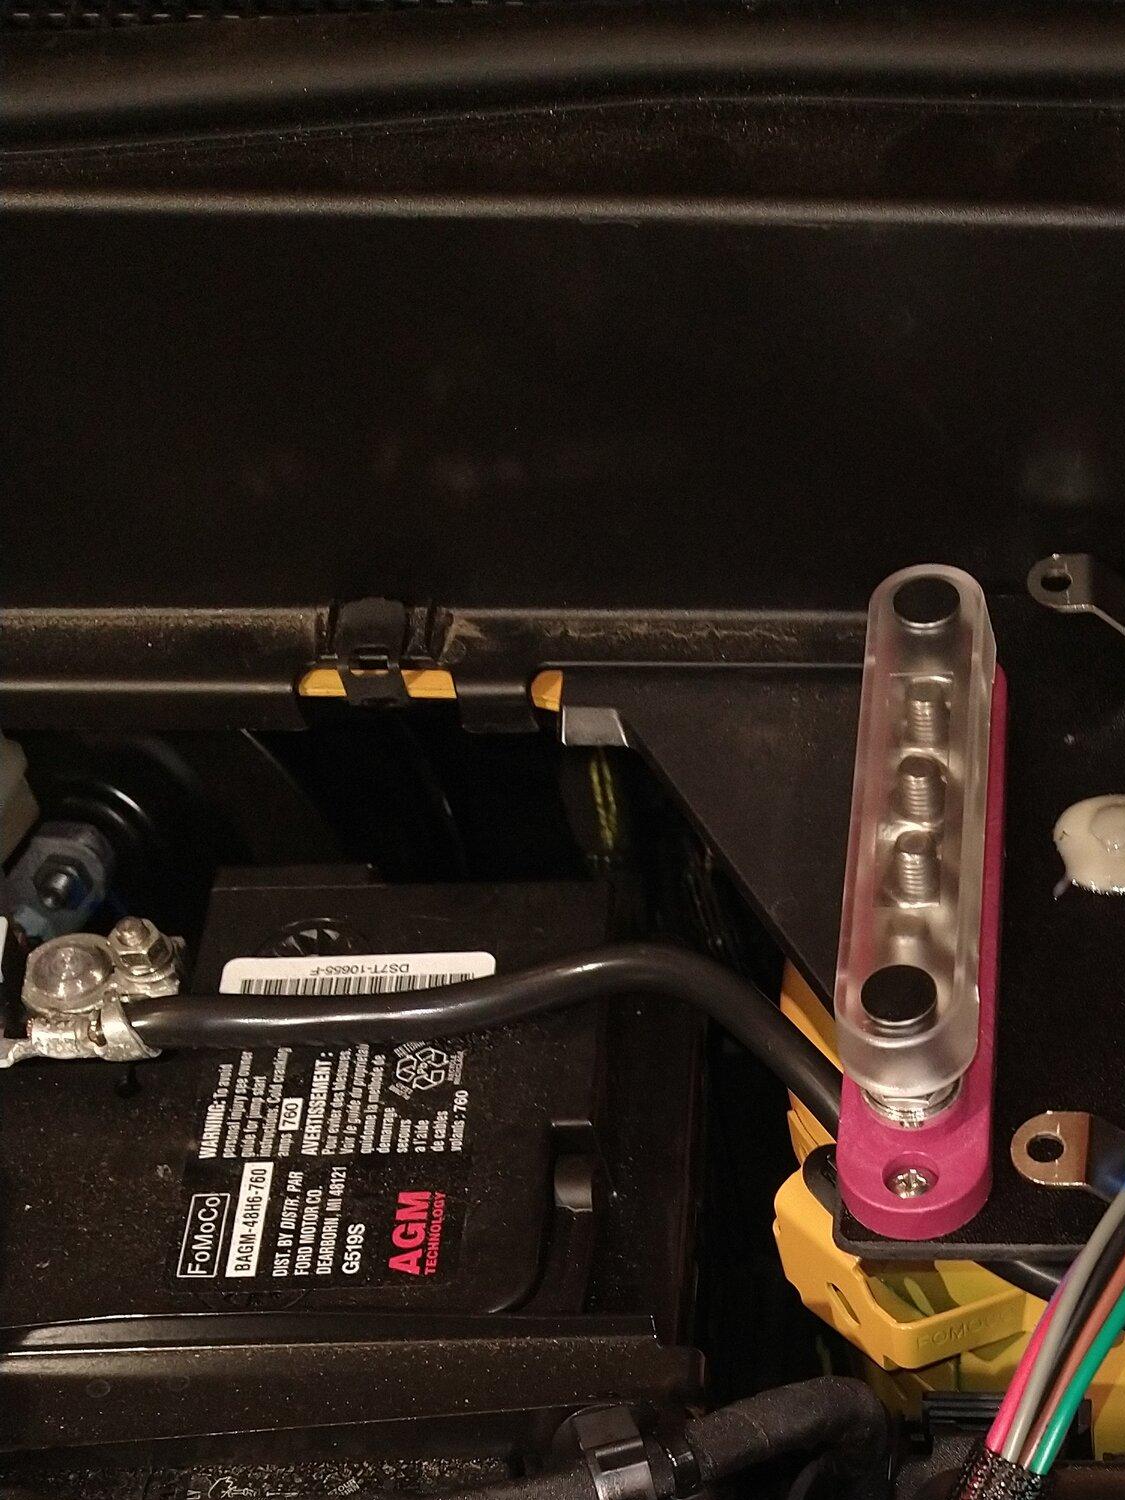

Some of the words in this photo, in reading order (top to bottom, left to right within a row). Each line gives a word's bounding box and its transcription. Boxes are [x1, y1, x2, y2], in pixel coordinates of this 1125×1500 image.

[218, 1064, 233, 1086] avoid
[238, 1051, 253, 1076] owner
[273, 1048, 292, 1082] cracking
[213, 1088, 228, 1099] To
[235, 1078, 248, 1093] see
[252, 1076, 267, 1096] start
[264, 1084, 283, 1103] Cold
[364, 1104, 378, 1113] la
[371, 1055, 385, 1065] de
[228, 1095, 248, 1120] injury
[245, 1097, 268, 1119] jump
[301, 1060, 332, 1155] AVERTISSEMENT
[346, 1100, 361, 1124] guide
[453, 1090, 468, 1112] 760
[243, 1120, 258, 1132] for
[282, 1103, 298, 1126] 760
[321, 1135, 337, 1155] Pour
[330, 1092, 345, 1108] des
[199, 1101, 226, 1158] WARNING:
[223, 1122, 240, 1158] personal
[257, 1105, 279, 1157] instructions.
[343, 1125, 357, 1134] le
[376, 1107, 397, 1153] demarrage
[397, 1119, 411, 1153] secours
[449, 1120, 465, 1151] volants
[240, 1134, 256, 1157] guide
[278, 1133, 294, 1158] amps
[339, 1137, 355, 1154] Voir
[430, 1140, 444, 1151] de
[287, 1172, 303, 1192] PAR
[329, 1167, 346, 1196] 48121
[306, 1186, 322, 1204] CO.
[326, 1199, 342, 1211] MI
[234, 1169, 267, 1271] BAGM-48H6-760
[280, 1196, 300, 1229] DISTR.
[299, 1206, 319, 1243] MOTOR
[187, 1197, 221, 1275] FoMoCo
[277, 1233, 293, 1246] BY
[316, 1214, 341, 1274] DEARBORN,
[389, 1191, 431, 1276] AGM
[425, 1192, 445, 1275] TECHNOLOGY
[294, 1247, 312, 1275] FORD
[342, 1224, 365, 1274] G519S
[272, 1250, 291, 1276] DIST.
